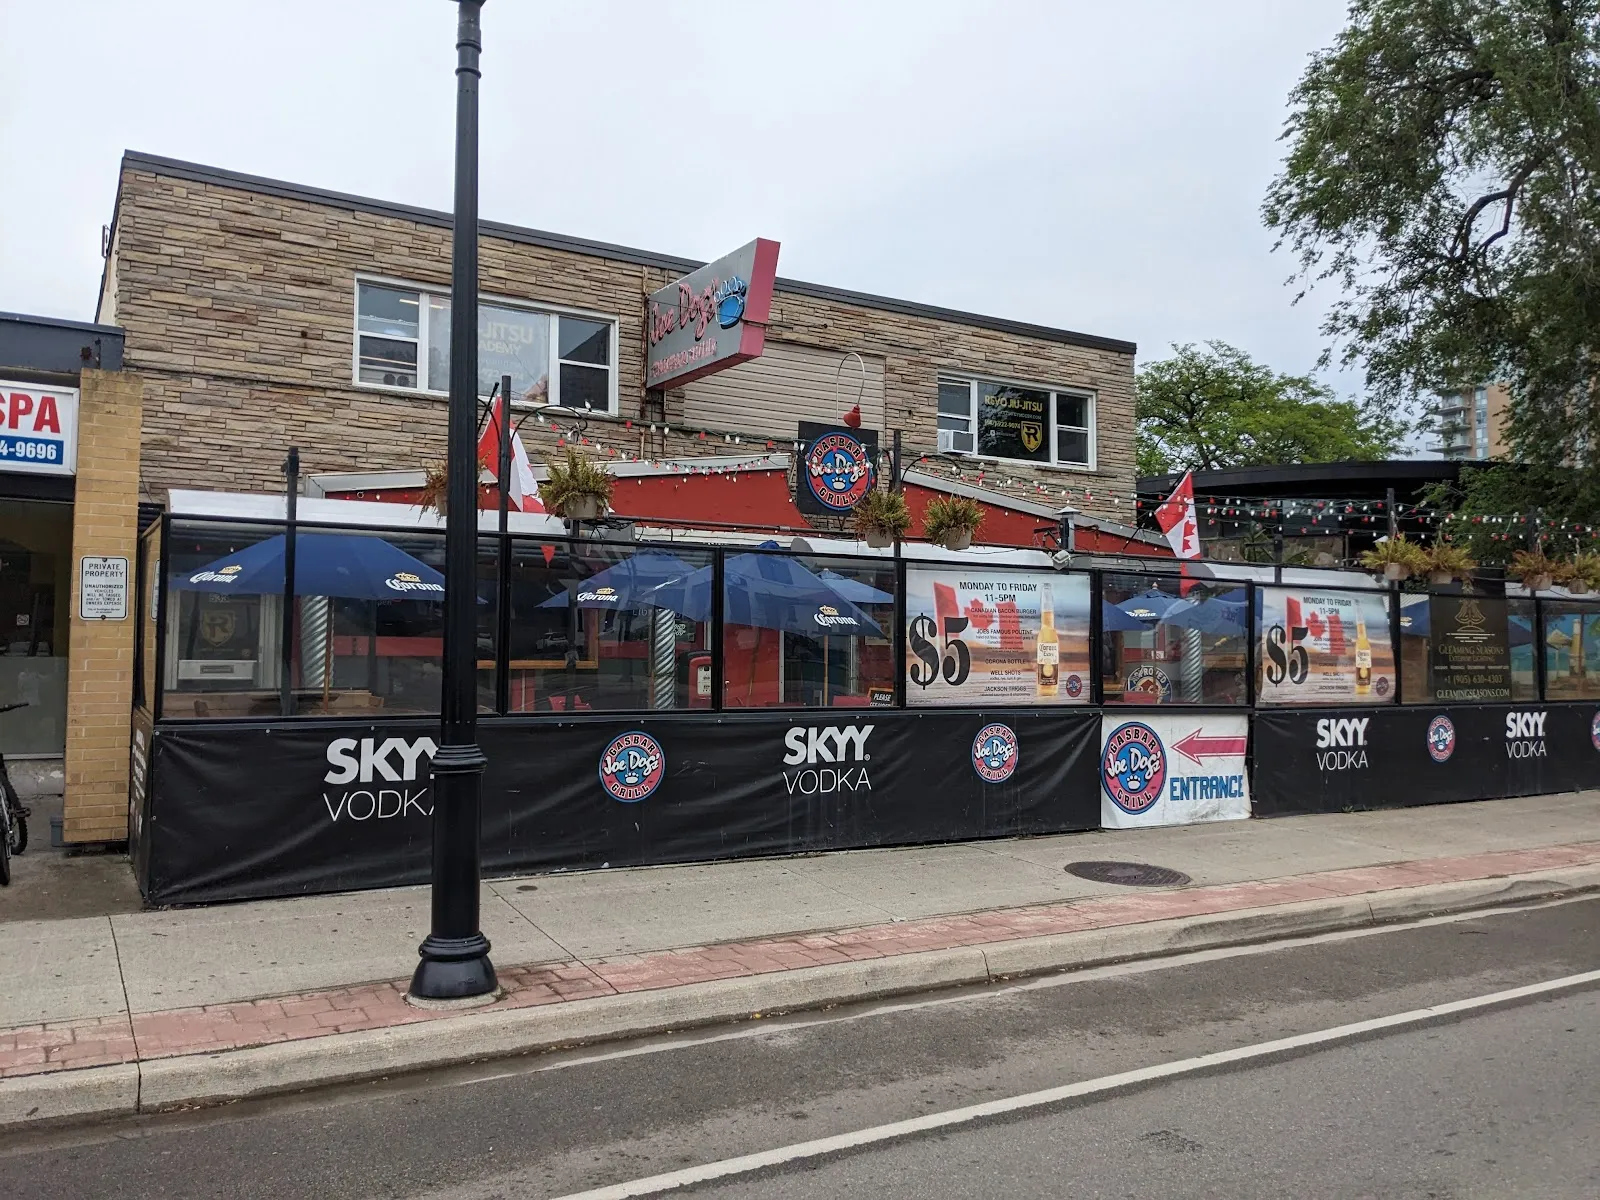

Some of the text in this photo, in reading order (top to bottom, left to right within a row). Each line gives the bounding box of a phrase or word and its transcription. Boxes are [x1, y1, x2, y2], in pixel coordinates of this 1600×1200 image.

[984, 395, 1043, 412] REVO JIU-JITSU
[814, 437, 862, 460] GASBAR
[819, 487, 859, 505] GRILL
[385, 578, 446, 593] Corona
[959, 581, 1037, 592] MONDAY TO FRIDAY
[577, 591, 619, 602] Corona
[985, 593, 1016, 602] 11-5PM
[1303, 596, 1326, 604] MONDAY
[813, 613, 861, 627] Corona
[909, 612, 971, 691] $5
[1266, 623, 1309, 688] $5
[1453, 674, 1471, 685] (905)
[874, 693, 891, 701] PLEASE
[1436, 688, 1510, 699] GLEAMINGSEASONS.COM
[978, 727, 1012, 744] GASBAR
[1109, 728, 1157, 754] GASBAR
[608, 735, 656, 756] GASBAR
[975, 742, 991, 759] Joe
[1505, 741, 1547, 759] VODKA
[604, 755, 627, 775] Joe
[1107, 753, 1127, 778] Joe
[1316, 750, 1368, 771] VODKA
[980, 766, 1009, 778] GRILL
[783, 768, 872, 795] VODKA
[1169, 775, 1244, 801] ENTRANCE
[611, 783, 650, 798] GRILL
[1117, 788, 1152, 808] GRILL
[323, 788, 435, 822] VODK
